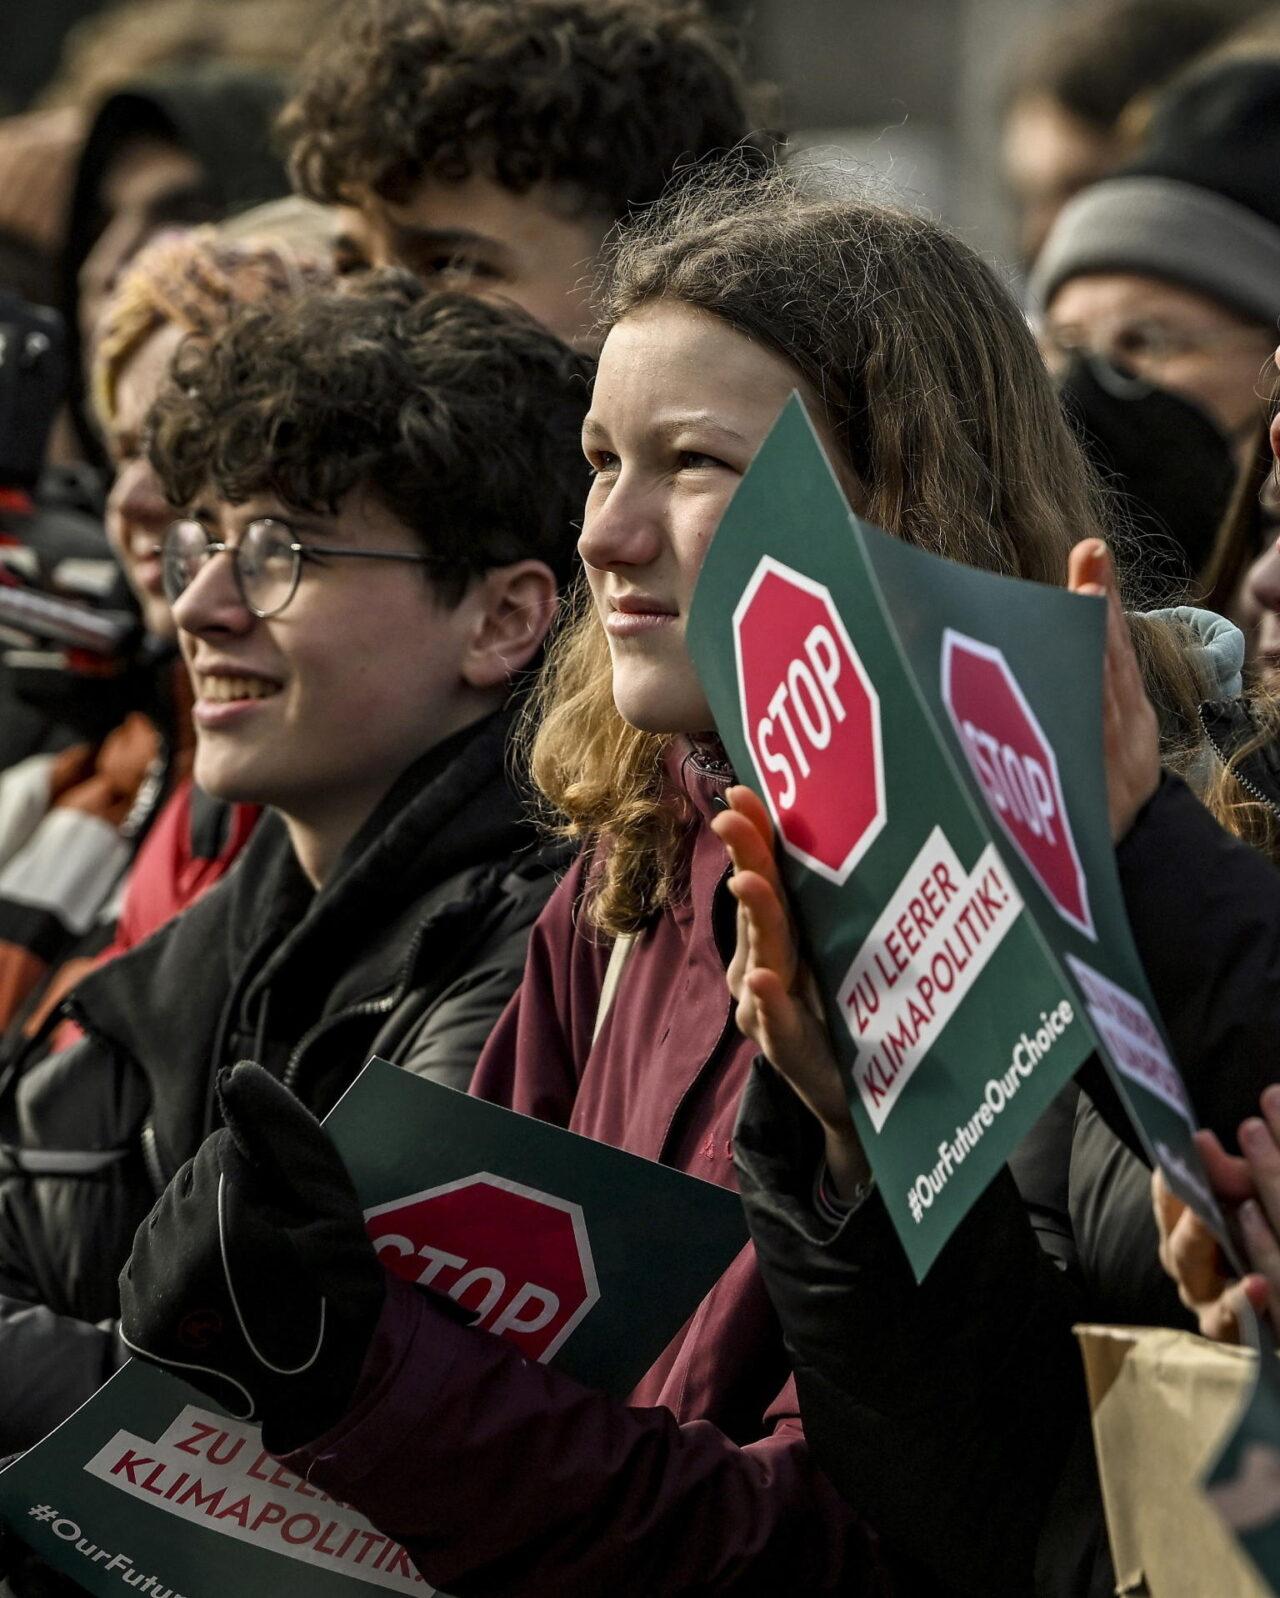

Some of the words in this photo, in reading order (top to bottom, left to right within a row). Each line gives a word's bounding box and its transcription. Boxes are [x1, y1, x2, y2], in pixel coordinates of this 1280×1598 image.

[758, 624, 847, 810] STOP
[962, 719, 1057, 847] STOP
[846, 971, 880, 1036] ZU
[874, 861, 960, 990] LEERER
[862, 867, 1010, 1108] KLIMAPOLITIK!
[907, 1000, 1075, 1225] #OurFutureOurChoice
[173, 1421, 247, 1465] ZU
